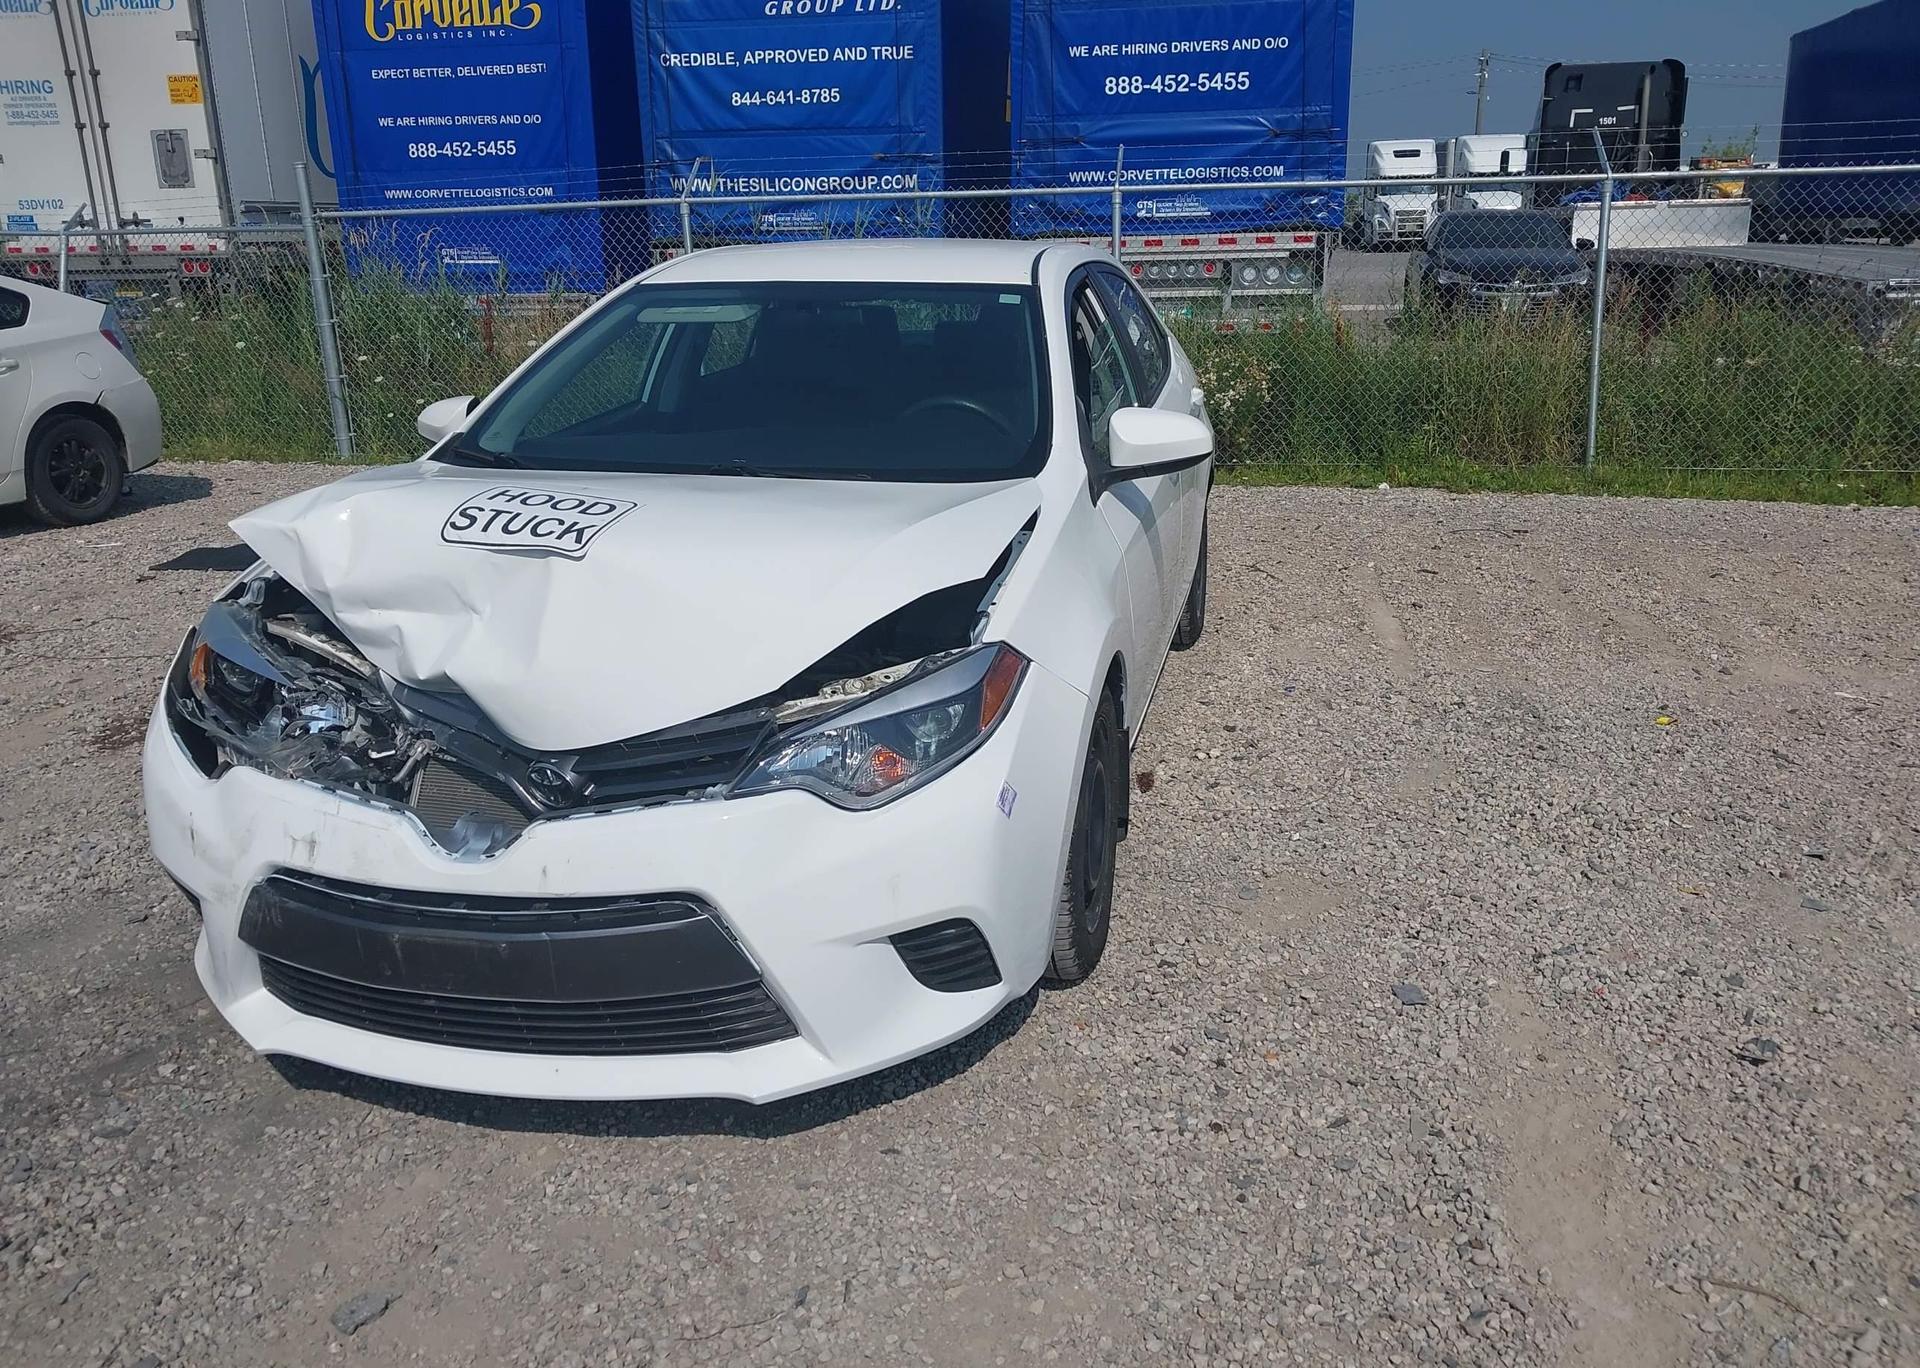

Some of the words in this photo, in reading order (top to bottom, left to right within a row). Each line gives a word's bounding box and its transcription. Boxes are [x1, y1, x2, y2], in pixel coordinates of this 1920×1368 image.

[765, 0, 844, 15] GROUP
[398, 30, 473, 41] LOGISTICS
[482, 29, 513, 38] INC.
[1069, 45, 1089, 57] WE
[1092, 44, 1119, 57] ARE
[1122, 42, 1168, 55] HIRING
[1171, 39, 1229, 53] DRIVERS
[1232, 37, 1261, 50] AND
[1264, 36, 1289, 49] O/O
[660, 51, 740, 67] CREDIBLE,
[743, 48, 829, 64] APPROVED
[833, 46, 867, 61] AND
[871, 45, 914, 60] TRUE
[371, 68, 410, 79] EXPECT
[412, 67, 455, 79] BETTER,
[457, 64, 514, 77] DELIVERED
[516, 62, 547, 74] BEST!
[0, 80, 54, 94] HIRING
[1104, 71, 1250, 95] 888-452-5455
[731, 87, 840, 106] 844-641-8785
[378, 117, 395, 127] WE
[396, 116, 416, 126] ARE
[418, 115, 453, 126] HIRING
[455, 115, 498, 125] DRIVERS
[500, 114, 521, 124] AND
[523, 114, 542, 124] O/O
[1599, 116, 1616, 125] 1501
[408, 140, 517, 158] 888-452-5455
[1069, 165, 1284, 182] WWW.CORVETTELOGISTICS.COM
[670, 173, 918, 193] WWWTHESILICONGROUP.COM
[384, 186, 553, 199] WWW.CORVETTELOGISTICS.COM
[18, 199, 64, 210] 53DV102
[487, 489, 617, 516] HOOD
[449, 506, 598, 545] STUCK
